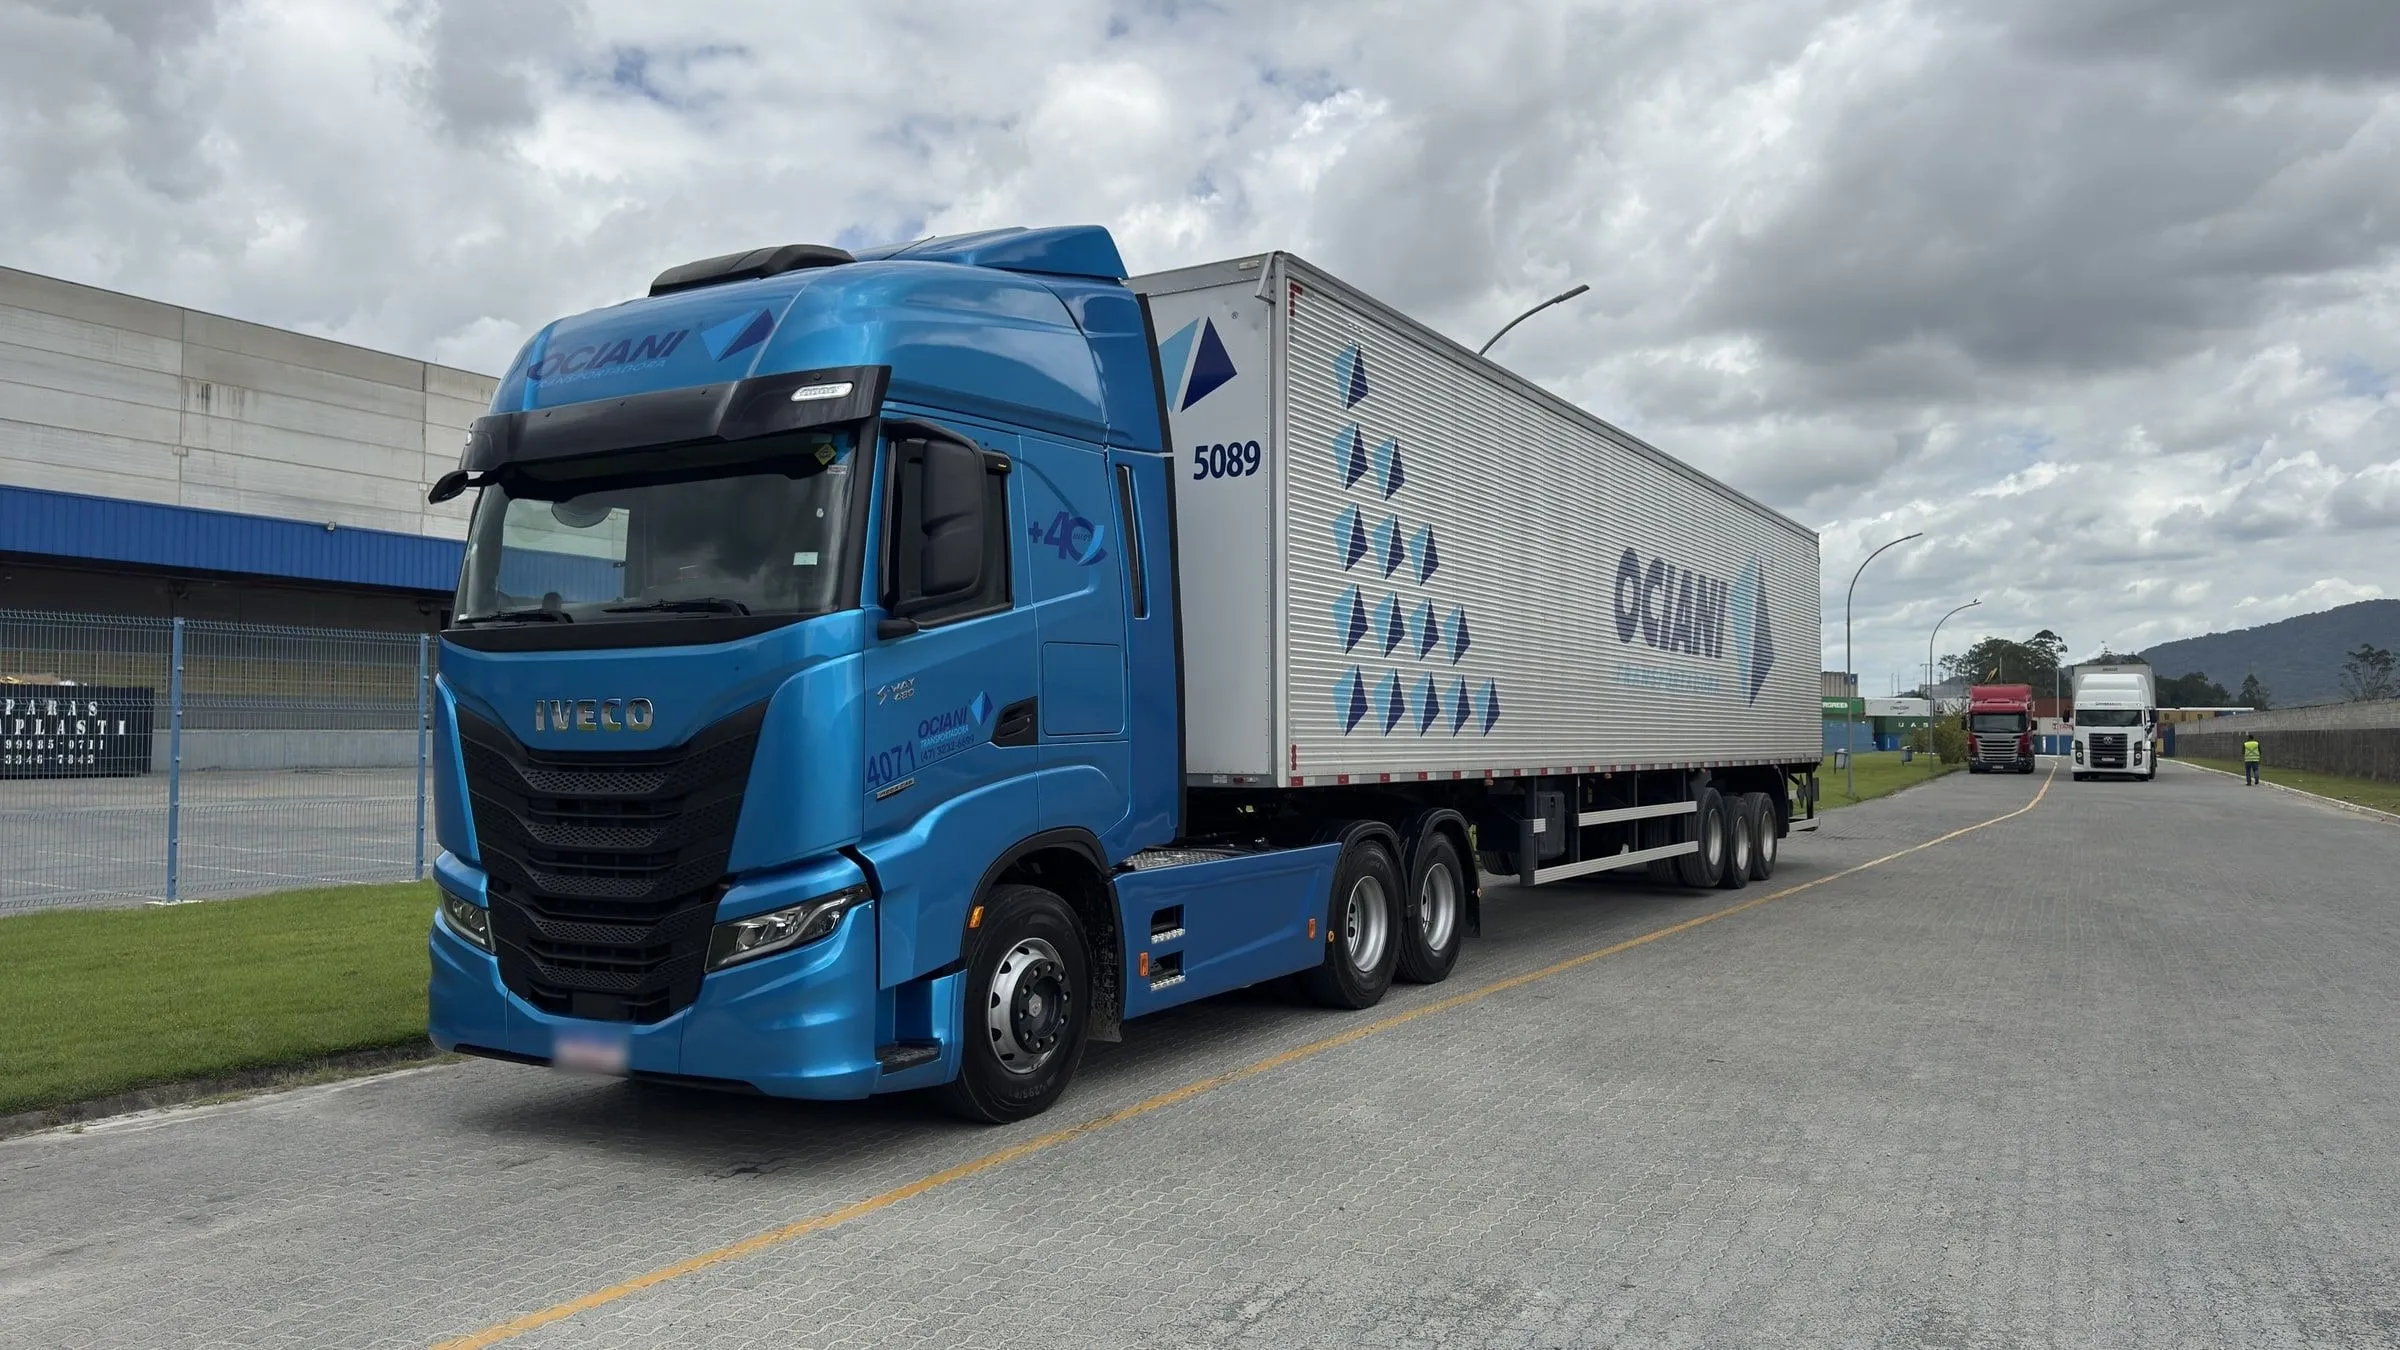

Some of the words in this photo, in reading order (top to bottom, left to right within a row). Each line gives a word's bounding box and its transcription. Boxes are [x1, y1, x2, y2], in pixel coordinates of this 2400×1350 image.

[527, 329, 690, 381] OCIANI
[1193, 440, 1261, 480] 5089
[1614, 547, 1727, 659] OCIANI
[535, 697, 654, 732] IVECO
[918, 706, 967, 739] OCIANI
[867, 740, 916, 786] 4071
